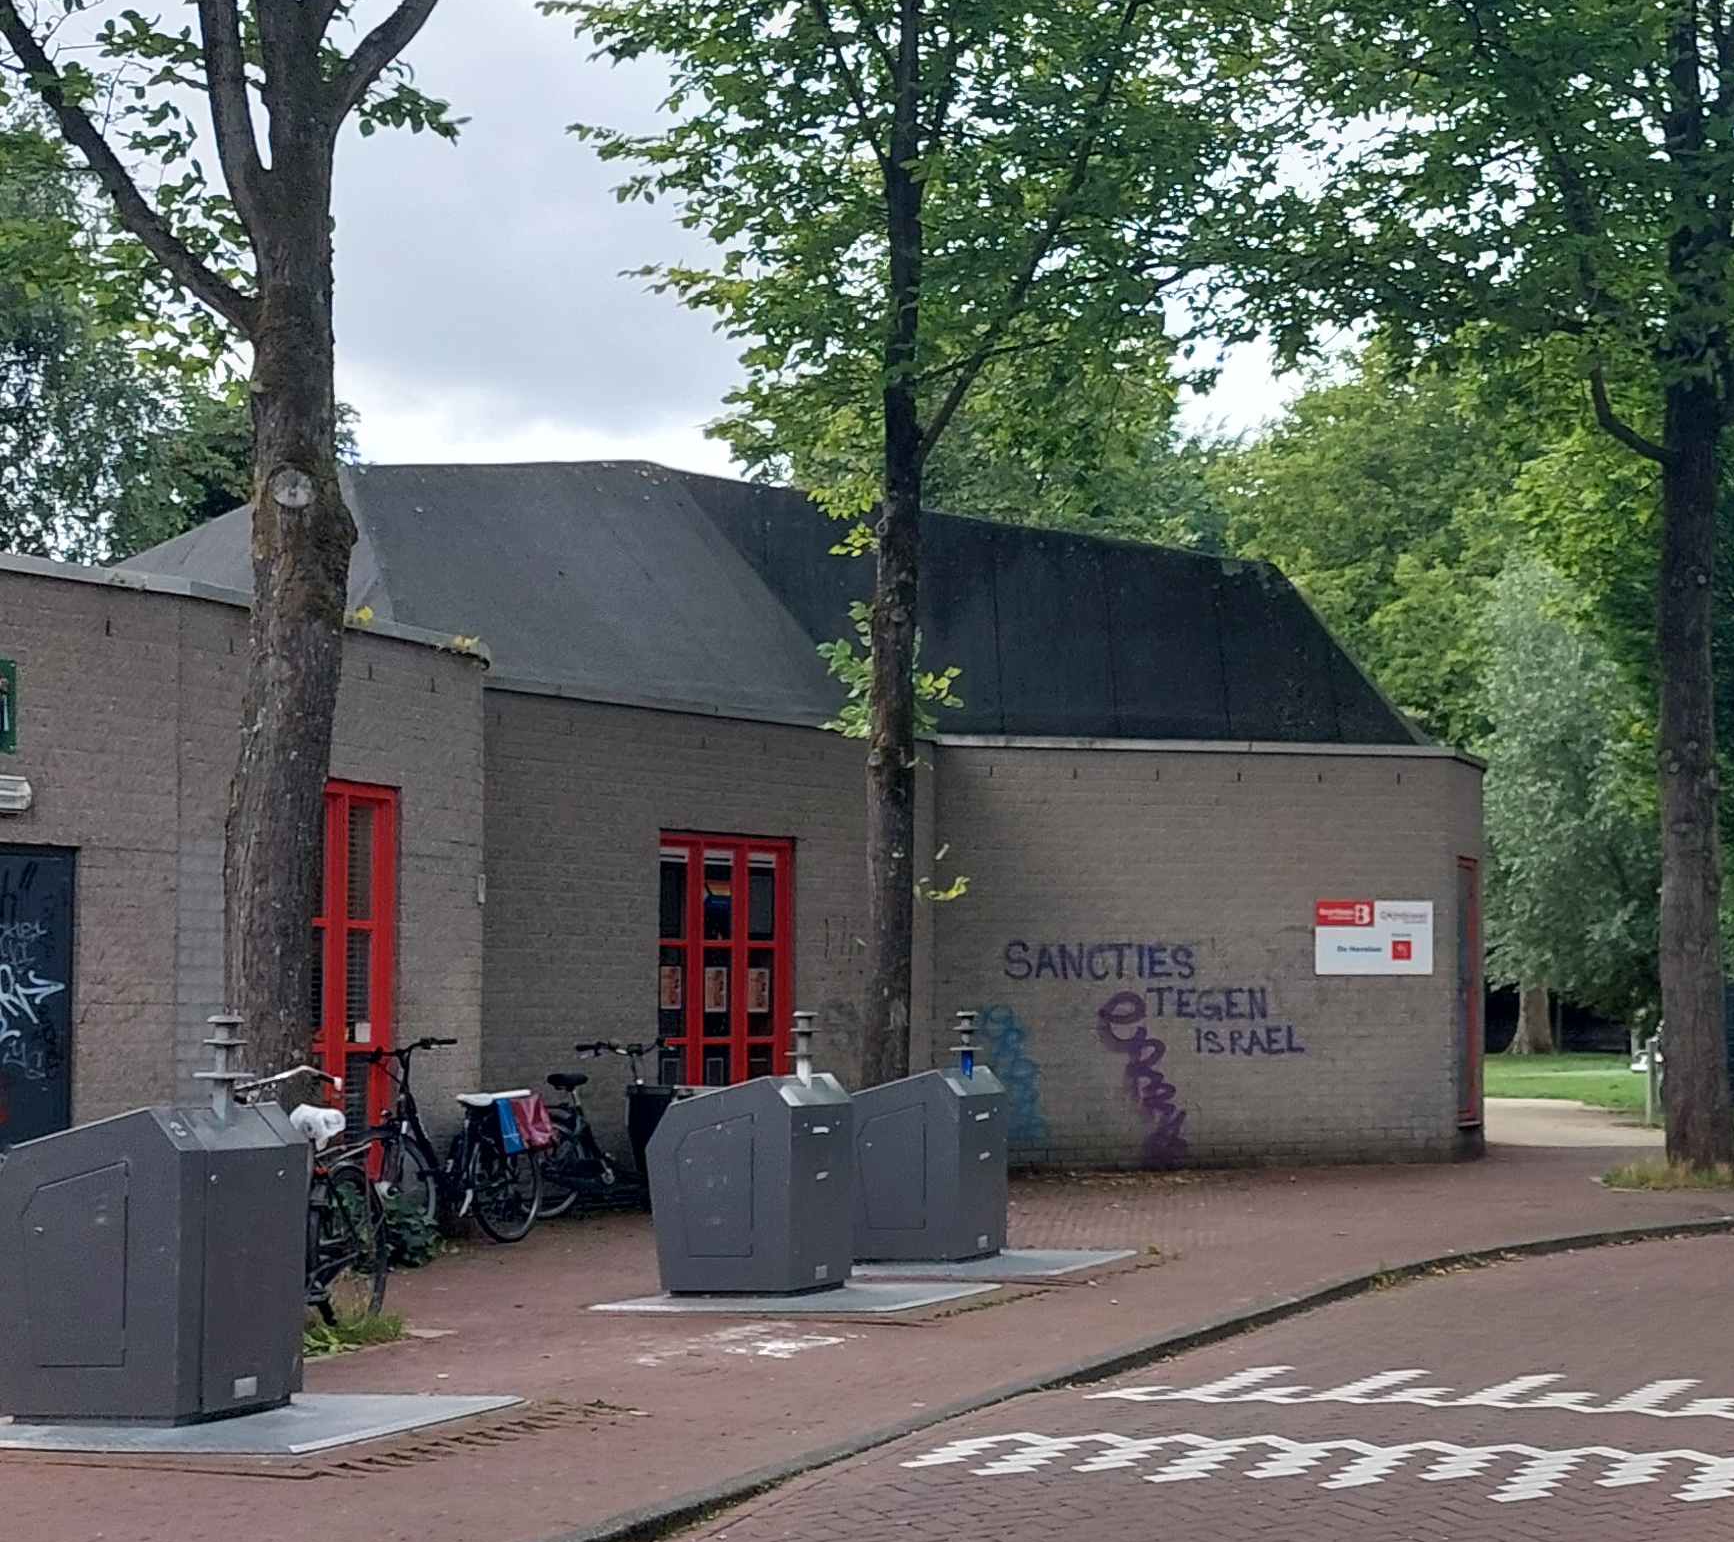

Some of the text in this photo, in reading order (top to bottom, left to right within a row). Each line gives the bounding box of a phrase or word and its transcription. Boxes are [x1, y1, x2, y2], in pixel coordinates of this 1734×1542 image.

[1003, 939, 1196, 981] SANCTIES
[1146, 987, 1268, 1022] TEGEN
[1195, 1025, 1306, 1056] ISRAEL
